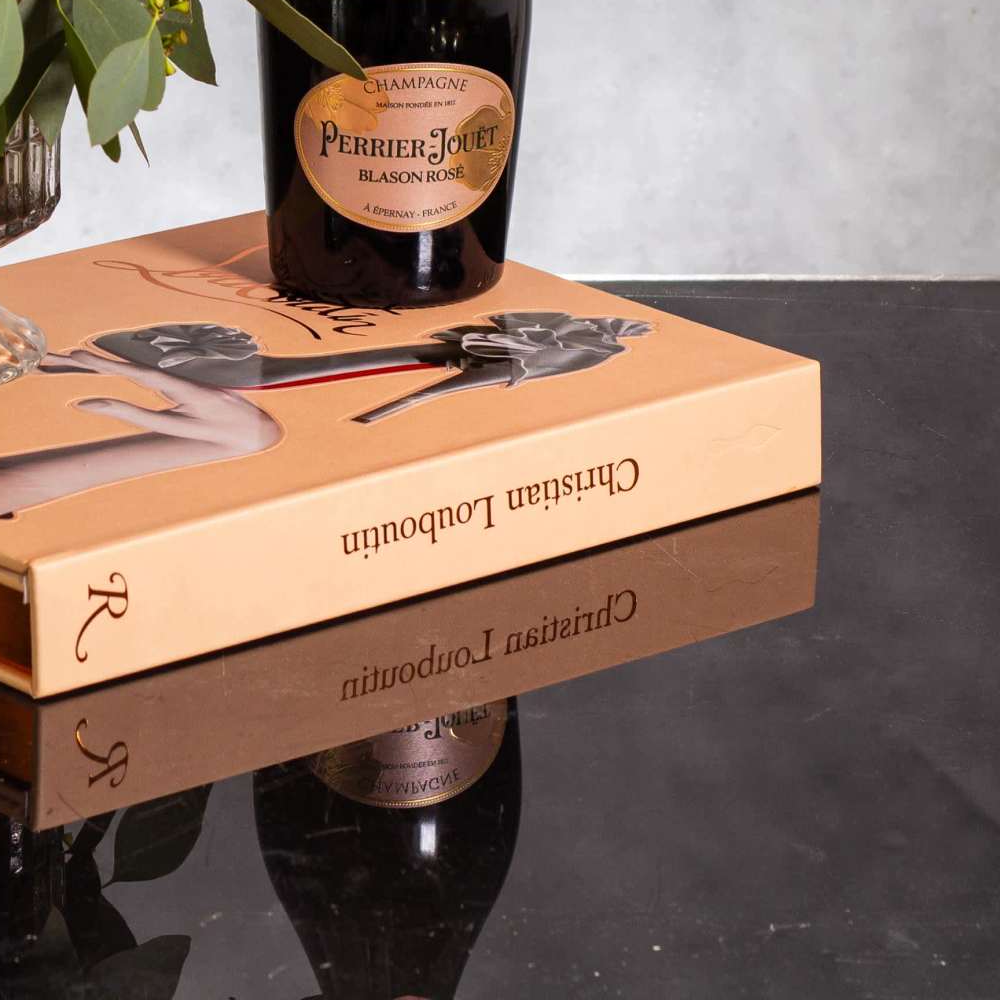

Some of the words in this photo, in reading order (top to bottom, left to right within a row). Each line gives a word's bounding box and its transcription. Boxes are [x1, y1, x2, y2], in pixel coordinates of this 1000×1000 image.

[363, 76, 468, 94] CHAMPAGNE
[376, 101, 404, 109] MAISON
[319, 120, 498, 165] PERRIER-JOUËT
[359, 168, 423, 184] BLASON
[426, 163, 464, 183] ROSÉ
[373, 206, 416, 218] ÉPERNAY
[422, 201, 458, 217] FRANCE
[506, 457, 640, 511] Christian
[340, 495, 496, 560] Louboutin
[75, 572, 129, 663] R
